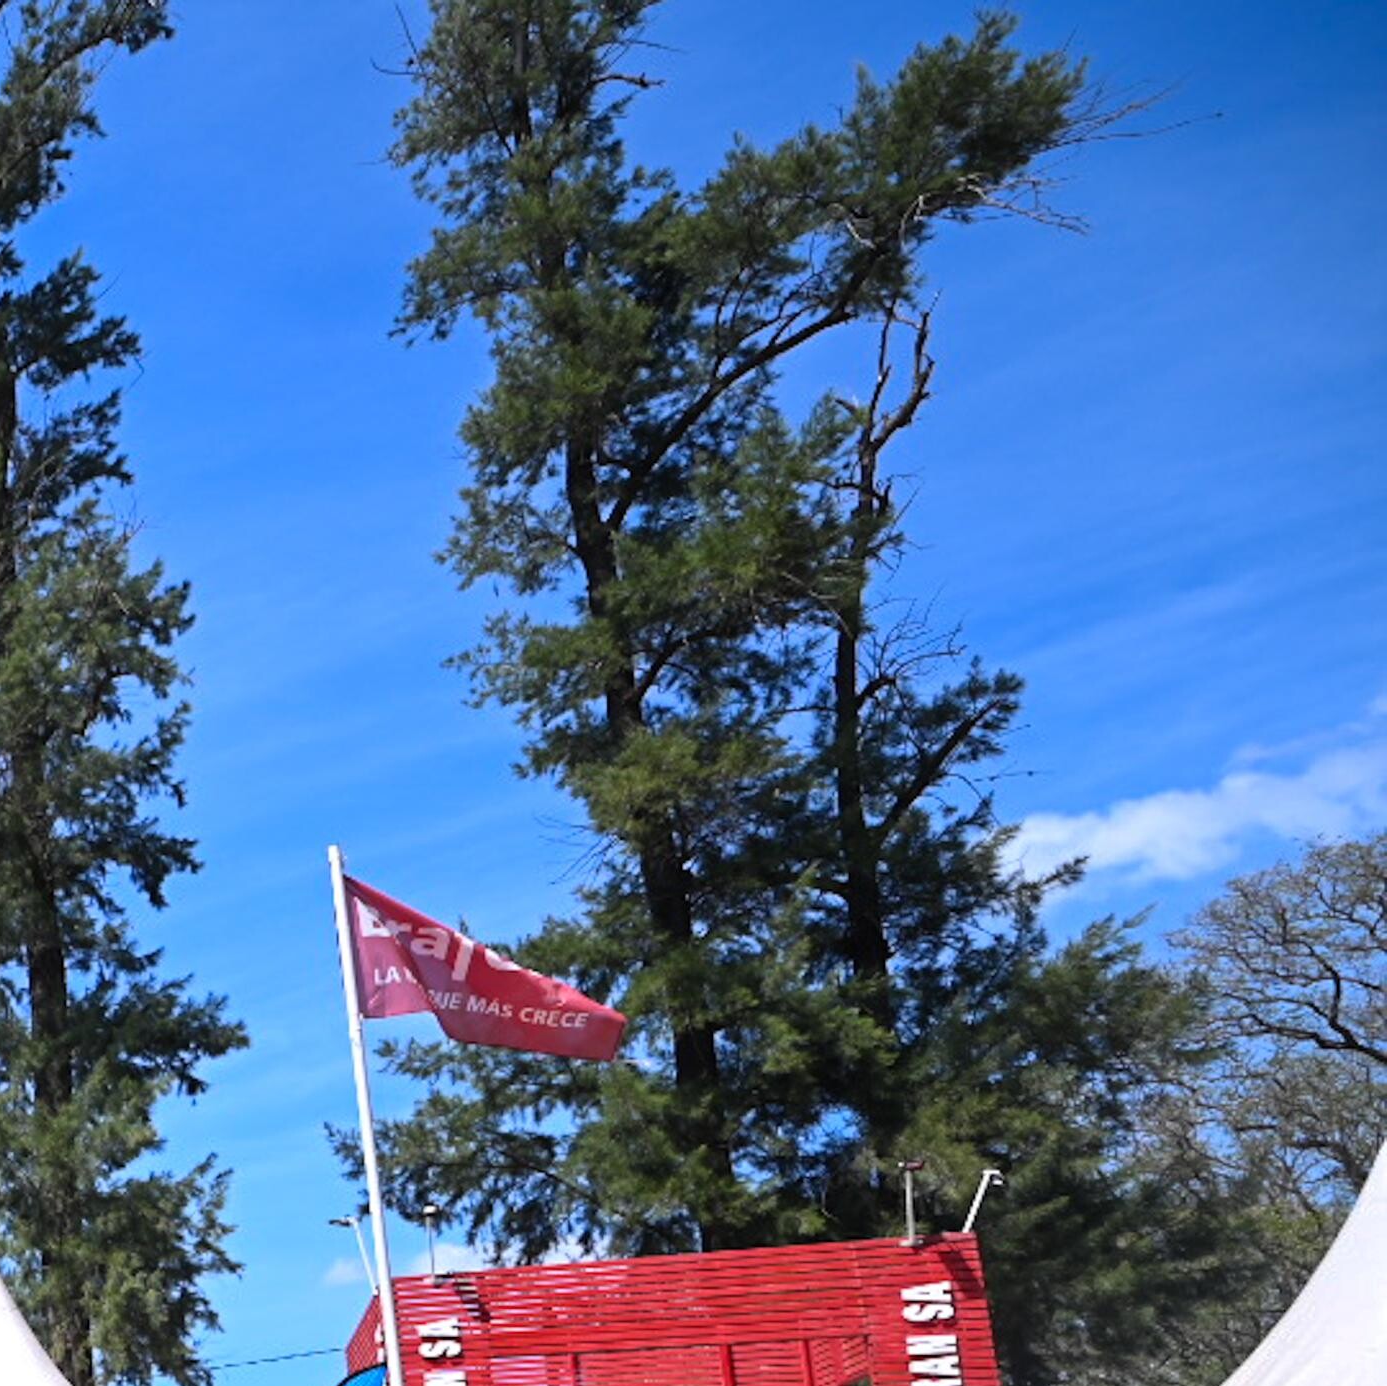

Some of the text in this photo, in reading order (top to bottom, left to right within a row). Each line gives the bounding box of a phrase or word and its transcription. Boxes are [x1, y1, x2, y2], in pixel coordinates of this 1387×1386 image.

[374, 966, 400, 986] LA
[518, 1006, 590, 1029] CRECE
[900, 1280, 955, 1324] SA
[419, 1317, 464, 1359] SA
